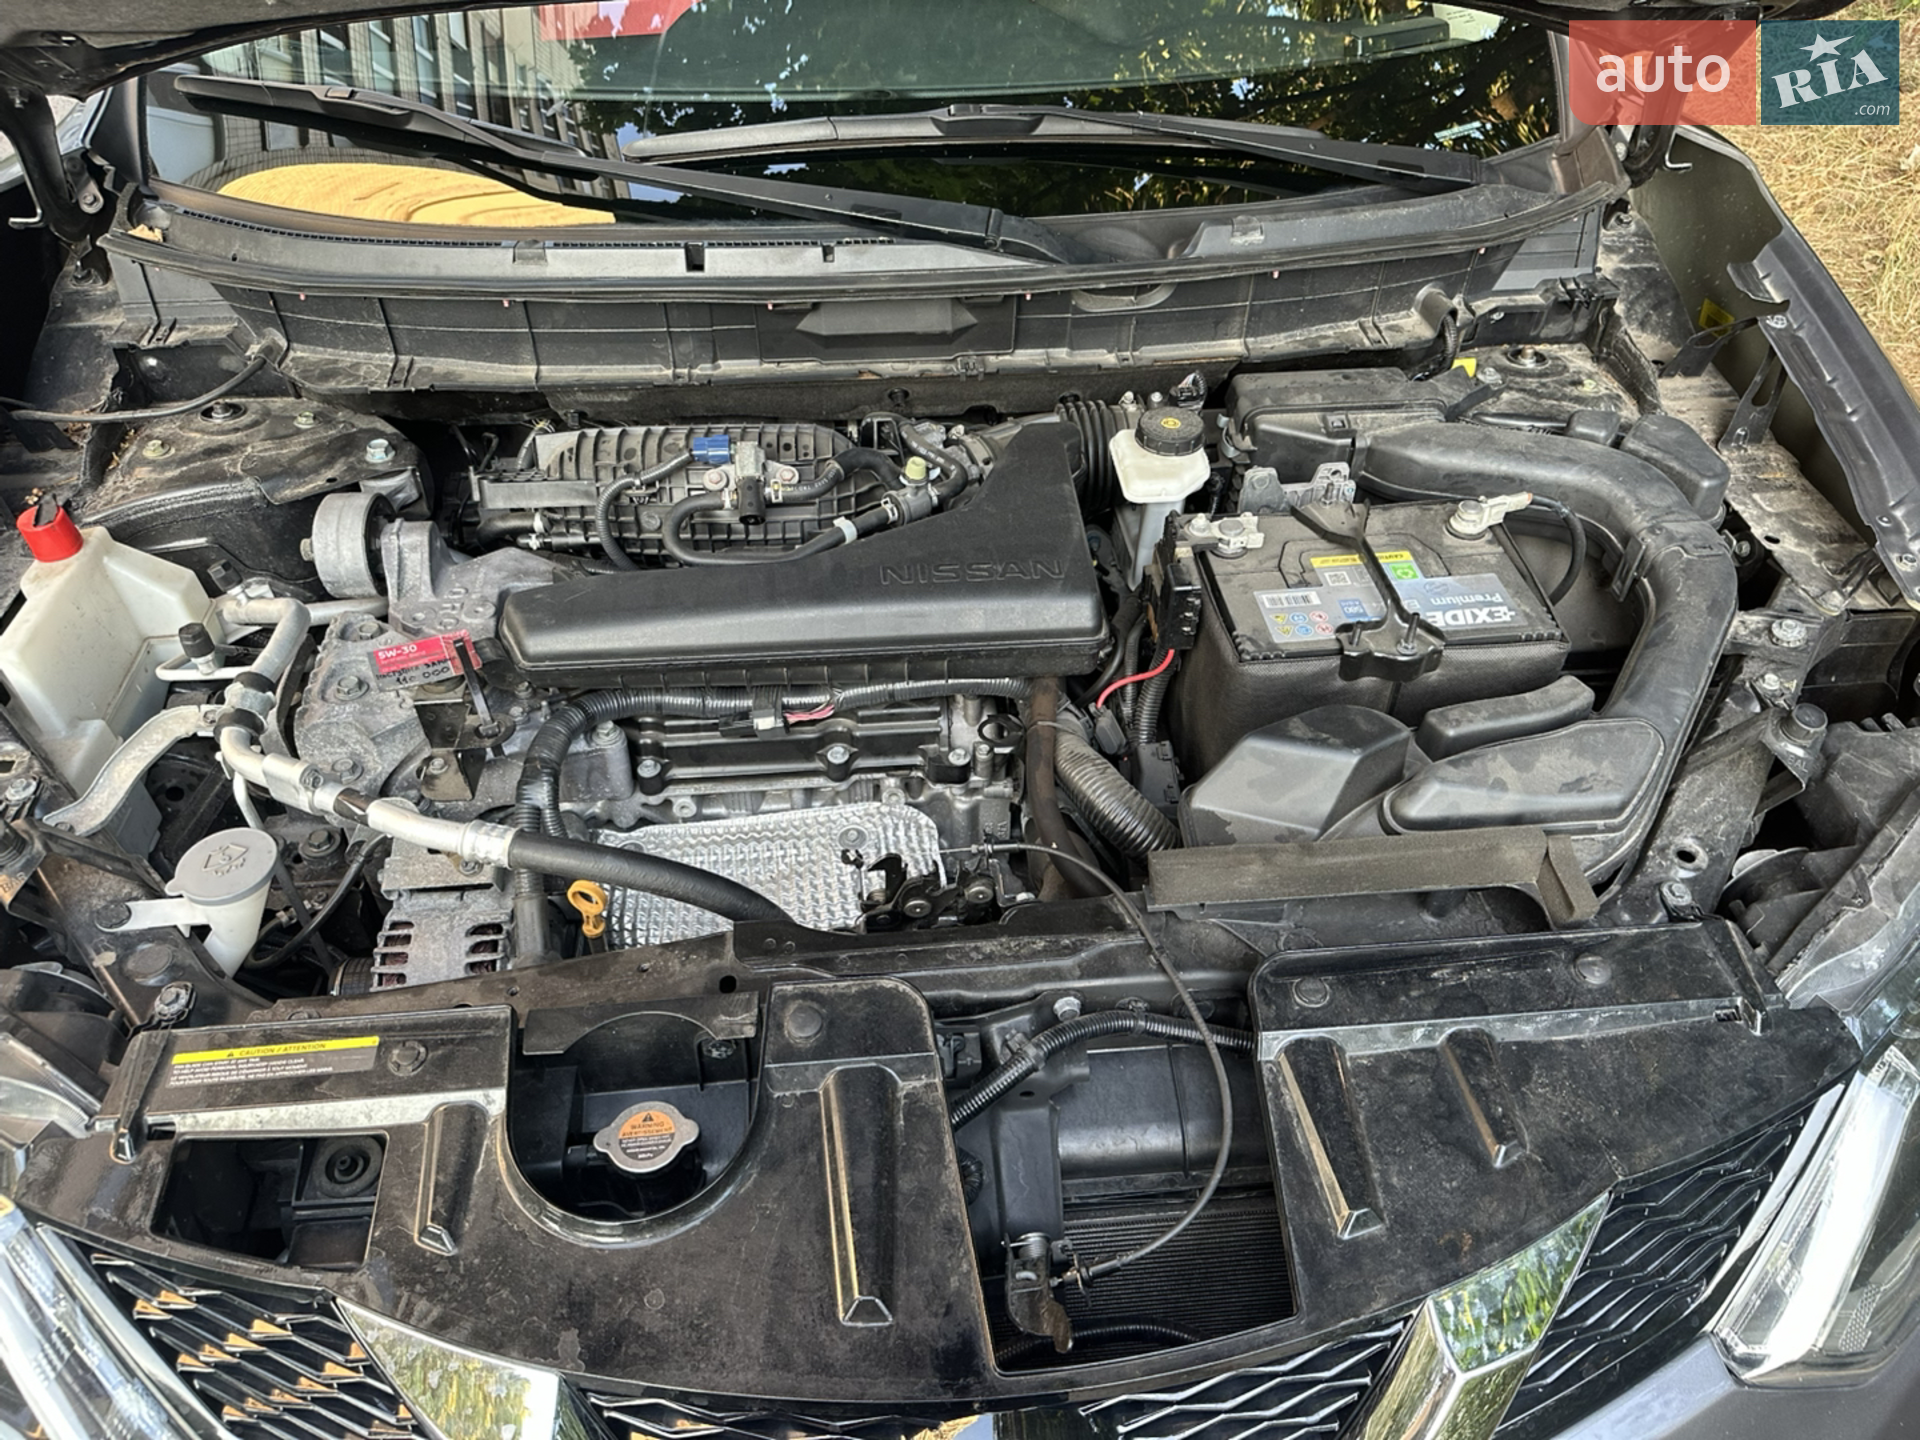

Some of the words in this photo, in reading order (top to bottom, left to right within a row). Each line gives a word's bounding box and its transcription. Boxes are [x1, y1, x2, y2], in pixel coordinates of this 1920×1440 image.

[880, 560, 1065, 585] NISSAN
[1430, 592, 1504, 606] Premium
[1425, 605, 1515, 627] EXIDE
[378, 644, 417, 660] 5W-30
[239, 1047, 275, 1056] CAUTION
[283, 1043, 326, 1052] ATTENTION
